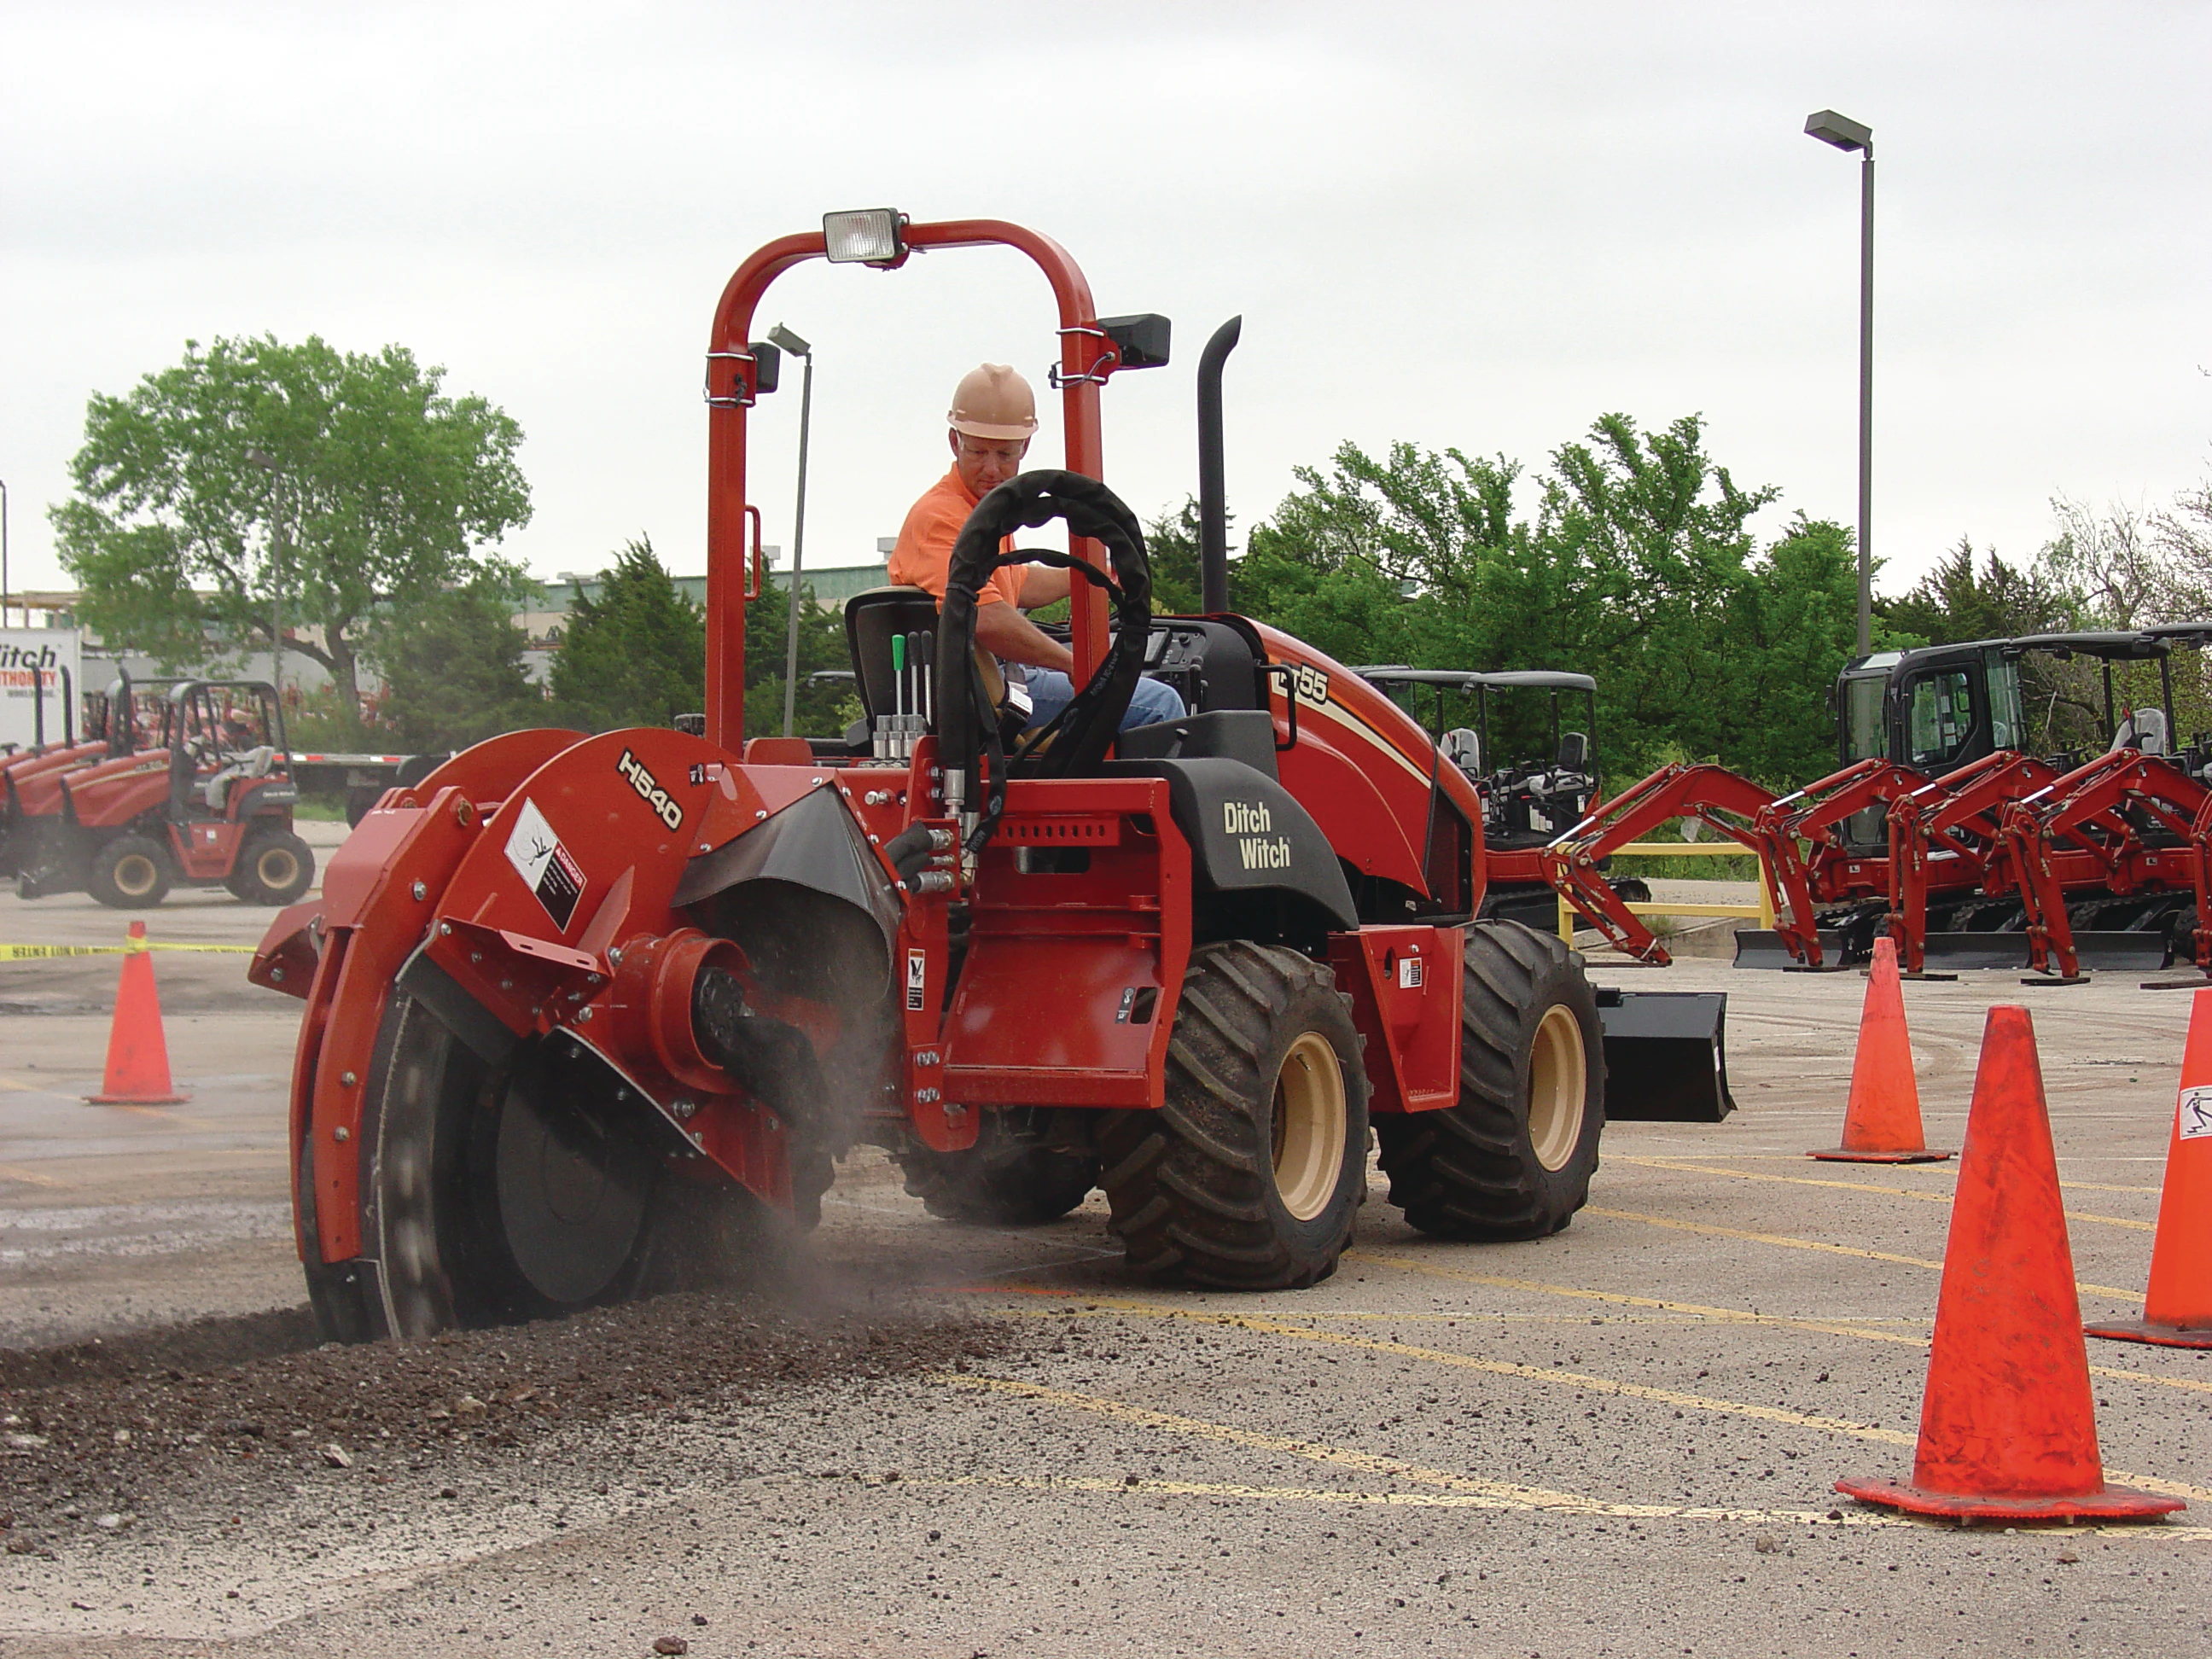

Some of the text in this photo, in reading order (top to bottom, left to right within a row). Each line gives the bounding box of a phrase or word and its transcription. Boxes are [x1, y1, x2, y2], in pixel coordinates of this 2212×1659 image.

[0, 643, 56, 667] itch
[618, 749, 683, 830] H540
[1223, 801, 1271, 834] Ditch
[560, 852, 584, 887] DANGER
[1239, 836, 1290, 870] Witch
